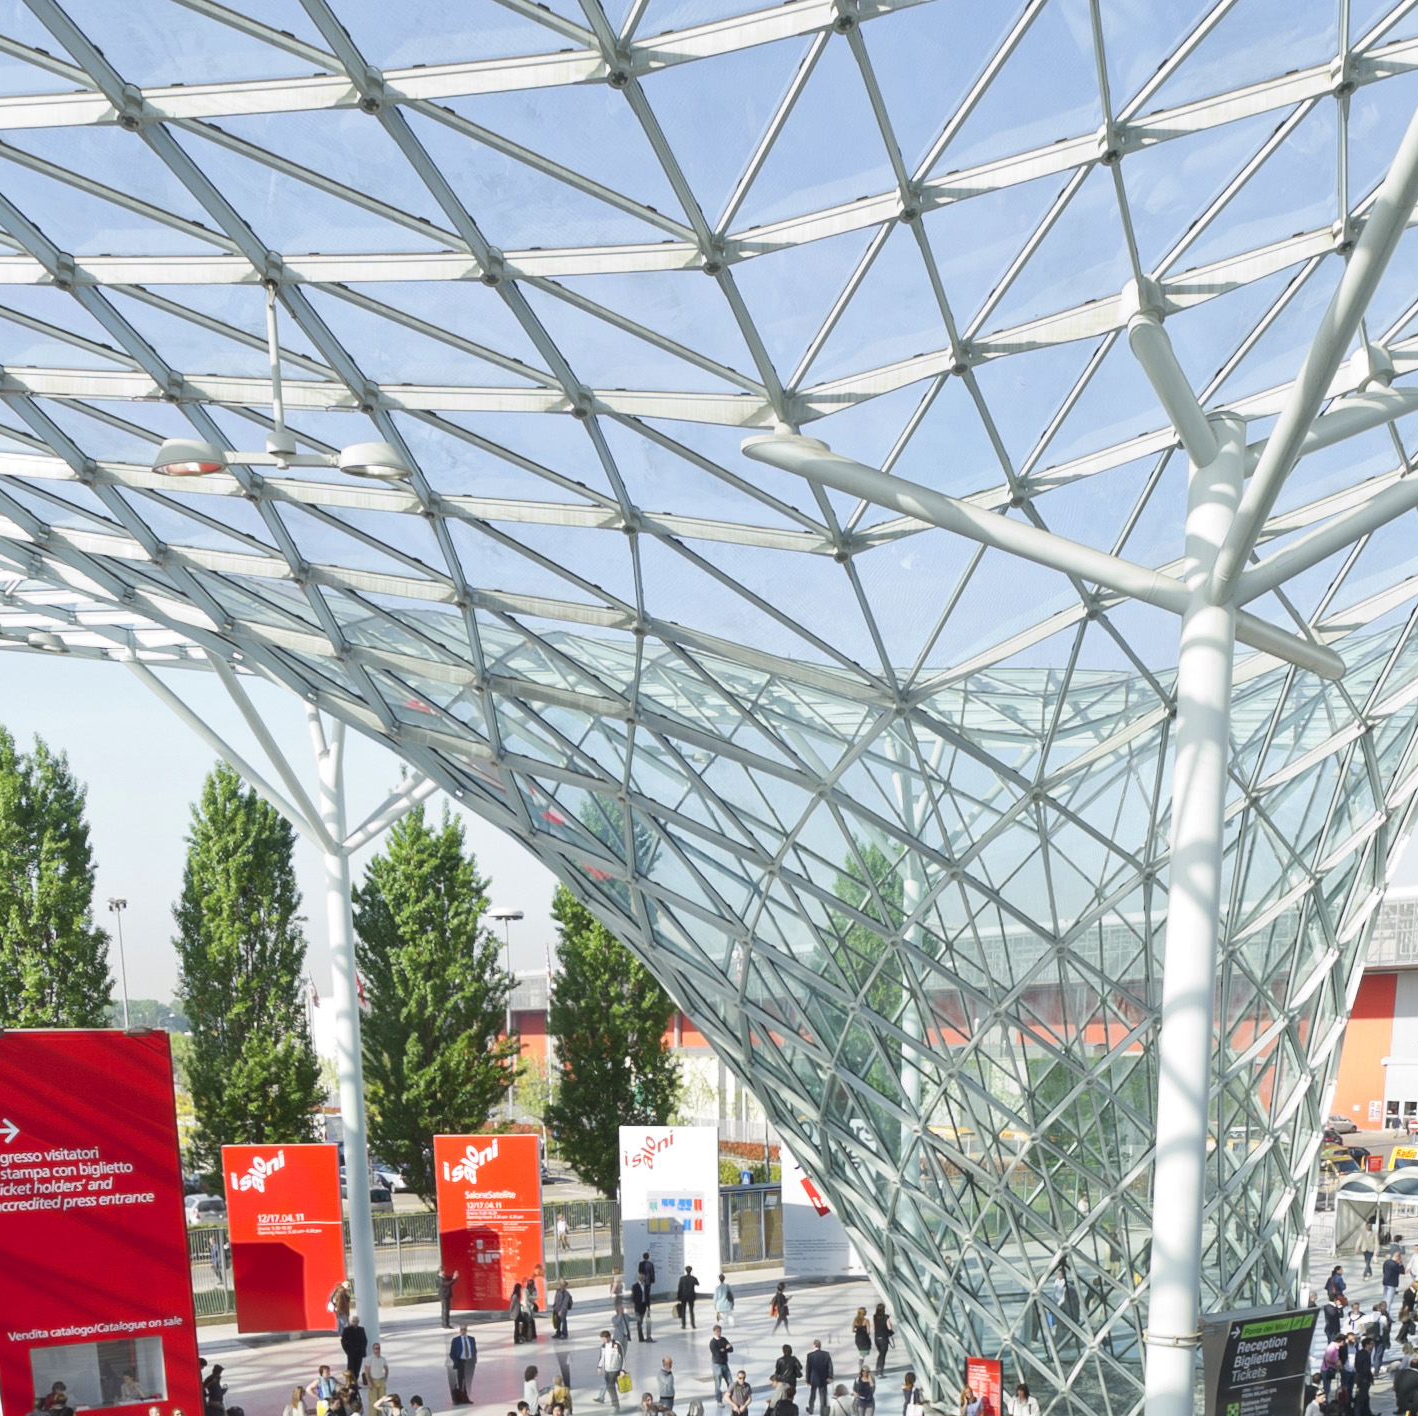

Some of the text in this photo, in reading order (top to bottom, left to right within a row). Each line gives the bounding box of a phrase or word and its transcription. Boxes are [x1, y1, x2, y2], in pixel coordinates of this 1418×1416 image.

[46, 1147, 99, 1162] visitatori
[2, 1166, 50, 1183] stampa
[53, 1166, 77, 1177] con
[80, 1160, 133, 1178] biglietto
[34, 1179, 85, 1194] holders'
[88, 1176, 113, 1190] and
[64, 1195, 96, 1210] press
[99, 1192, 155, 1207] entrance
[257, 1213, 304, 1223] 12/17.04.11
[8, 1316, 183, 1342] Vendita catalogo/Catalogue on sale
[1237, 1337, 1287, 1353] Reception
[1234, 1349, 1287, 1368] Biglietterie
[1232, 1367, 1267, 1382] Tickets
